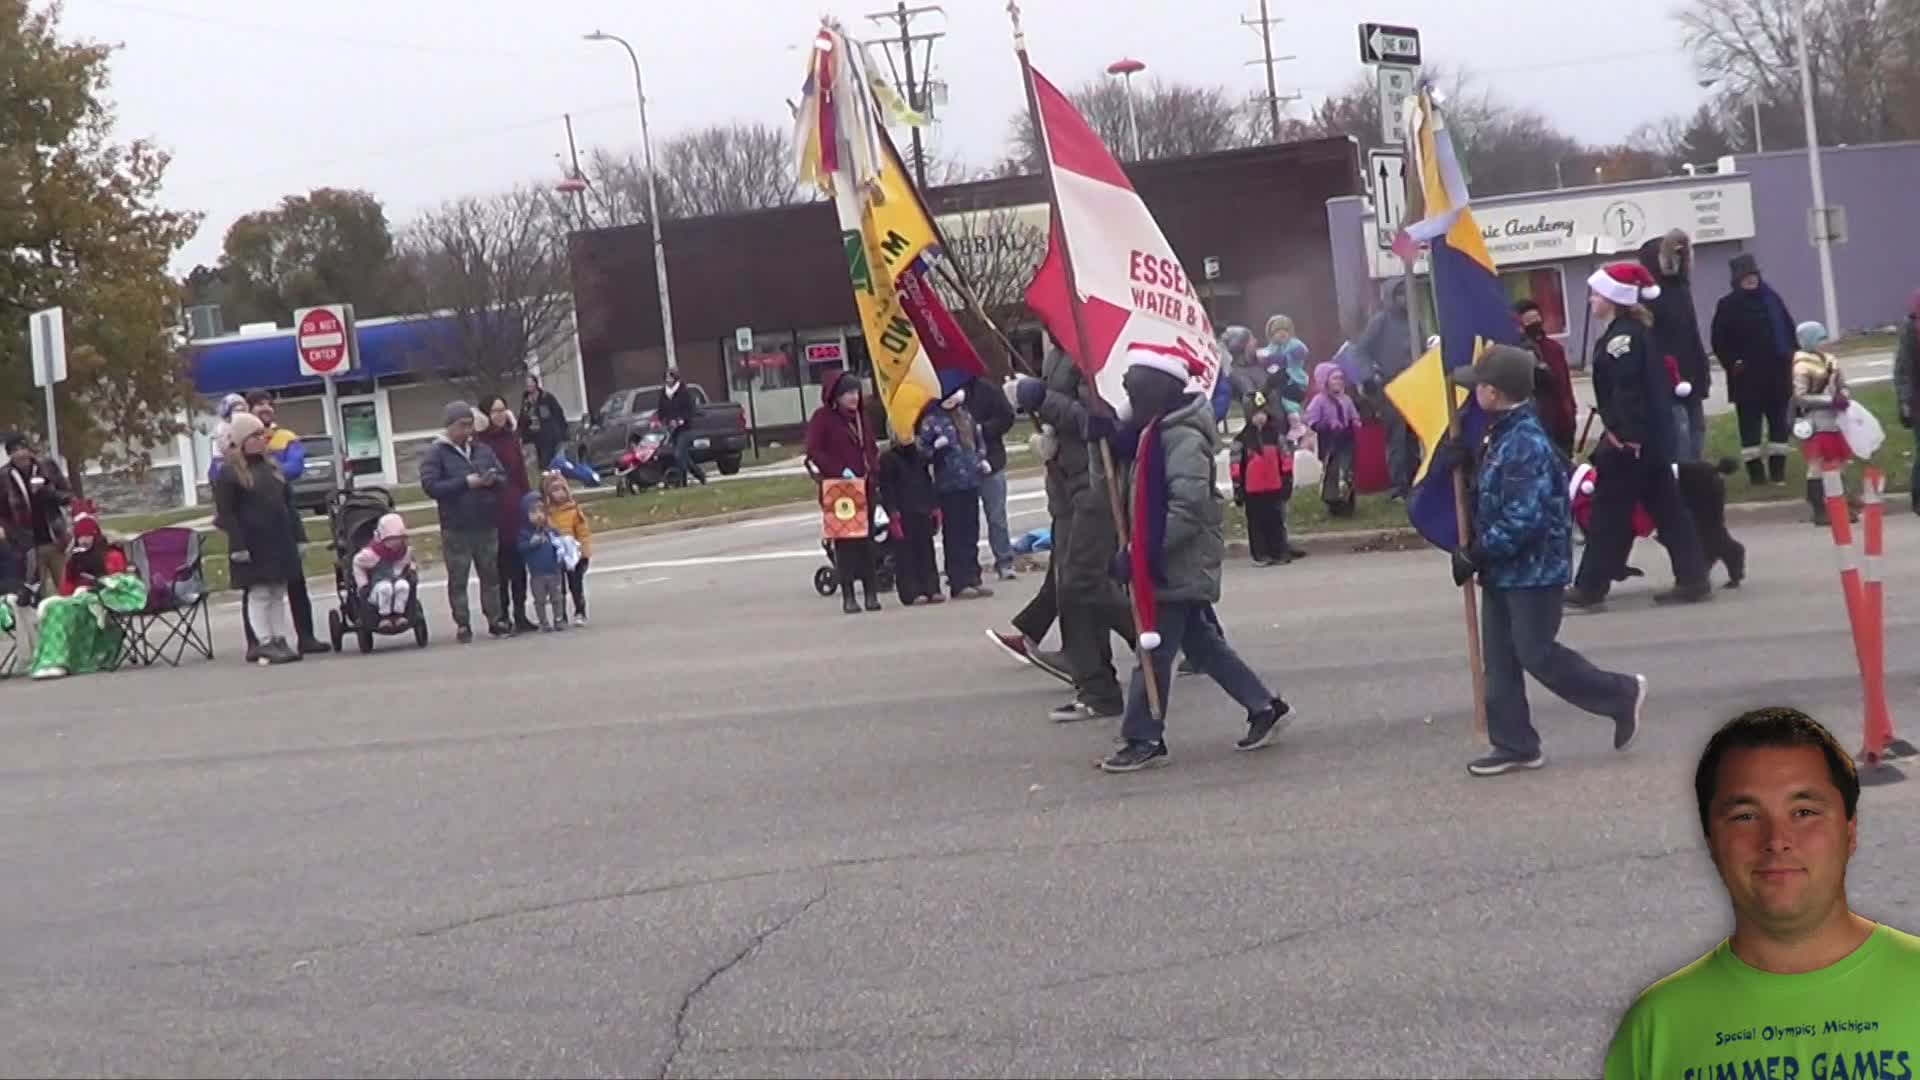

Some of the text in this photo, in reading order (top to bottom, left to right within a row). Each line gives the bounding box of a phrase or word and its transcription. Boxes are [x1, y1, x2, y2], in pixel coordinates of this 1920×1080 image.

[1504, 215, 1575, 238] Academy
[1131, 287, 1182, 322] WATER
[1186, 304, 1197, 327] &
[309, 348, 337, 362] ENTER
[1715, 1019, 1879, 1046] Special Olympics Michigan
[1811, 1050, 1913, 1080] GAMES
